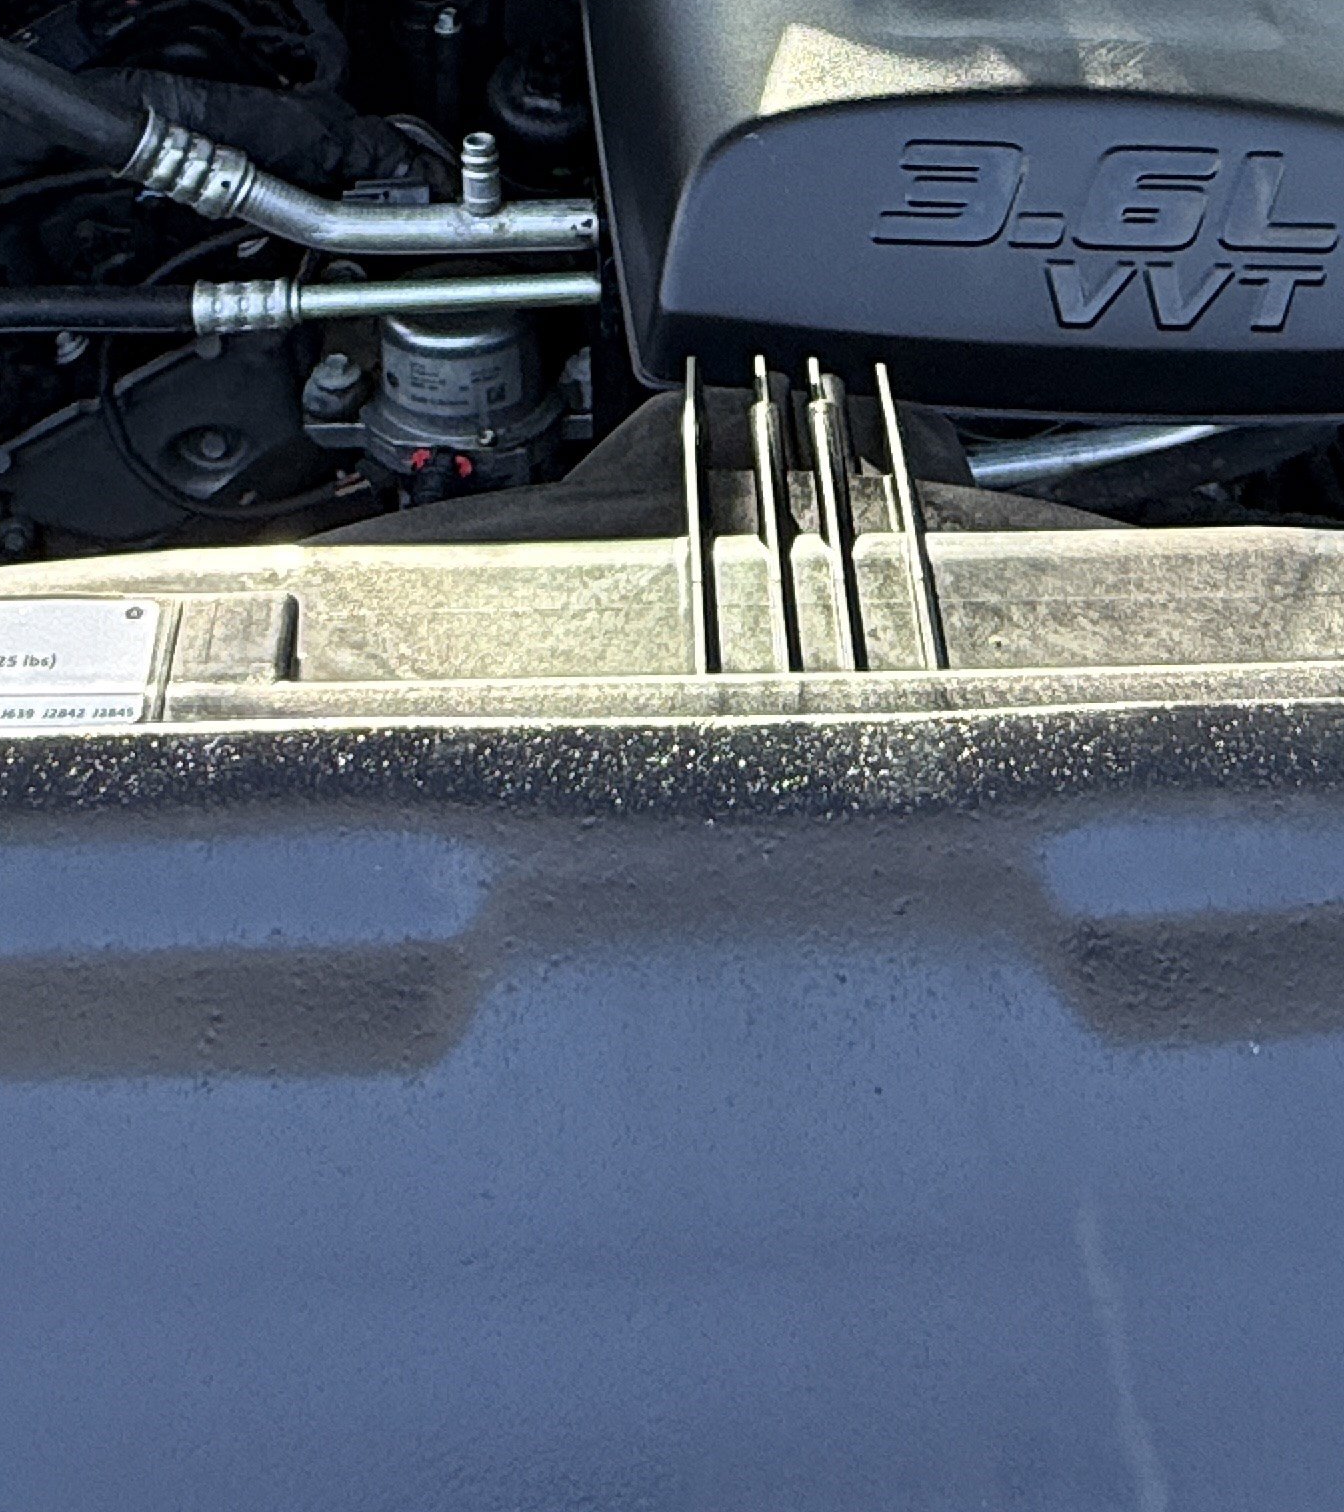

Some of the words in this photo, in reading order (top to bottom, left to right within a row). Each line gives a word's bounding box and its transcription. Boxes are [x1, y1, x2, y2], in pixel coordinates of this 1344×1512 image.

[869, 138, 1341, 255] 3.6L
[1045, 258, 1328, 334] VVT
[22, 653, 57, 670] lbs)
